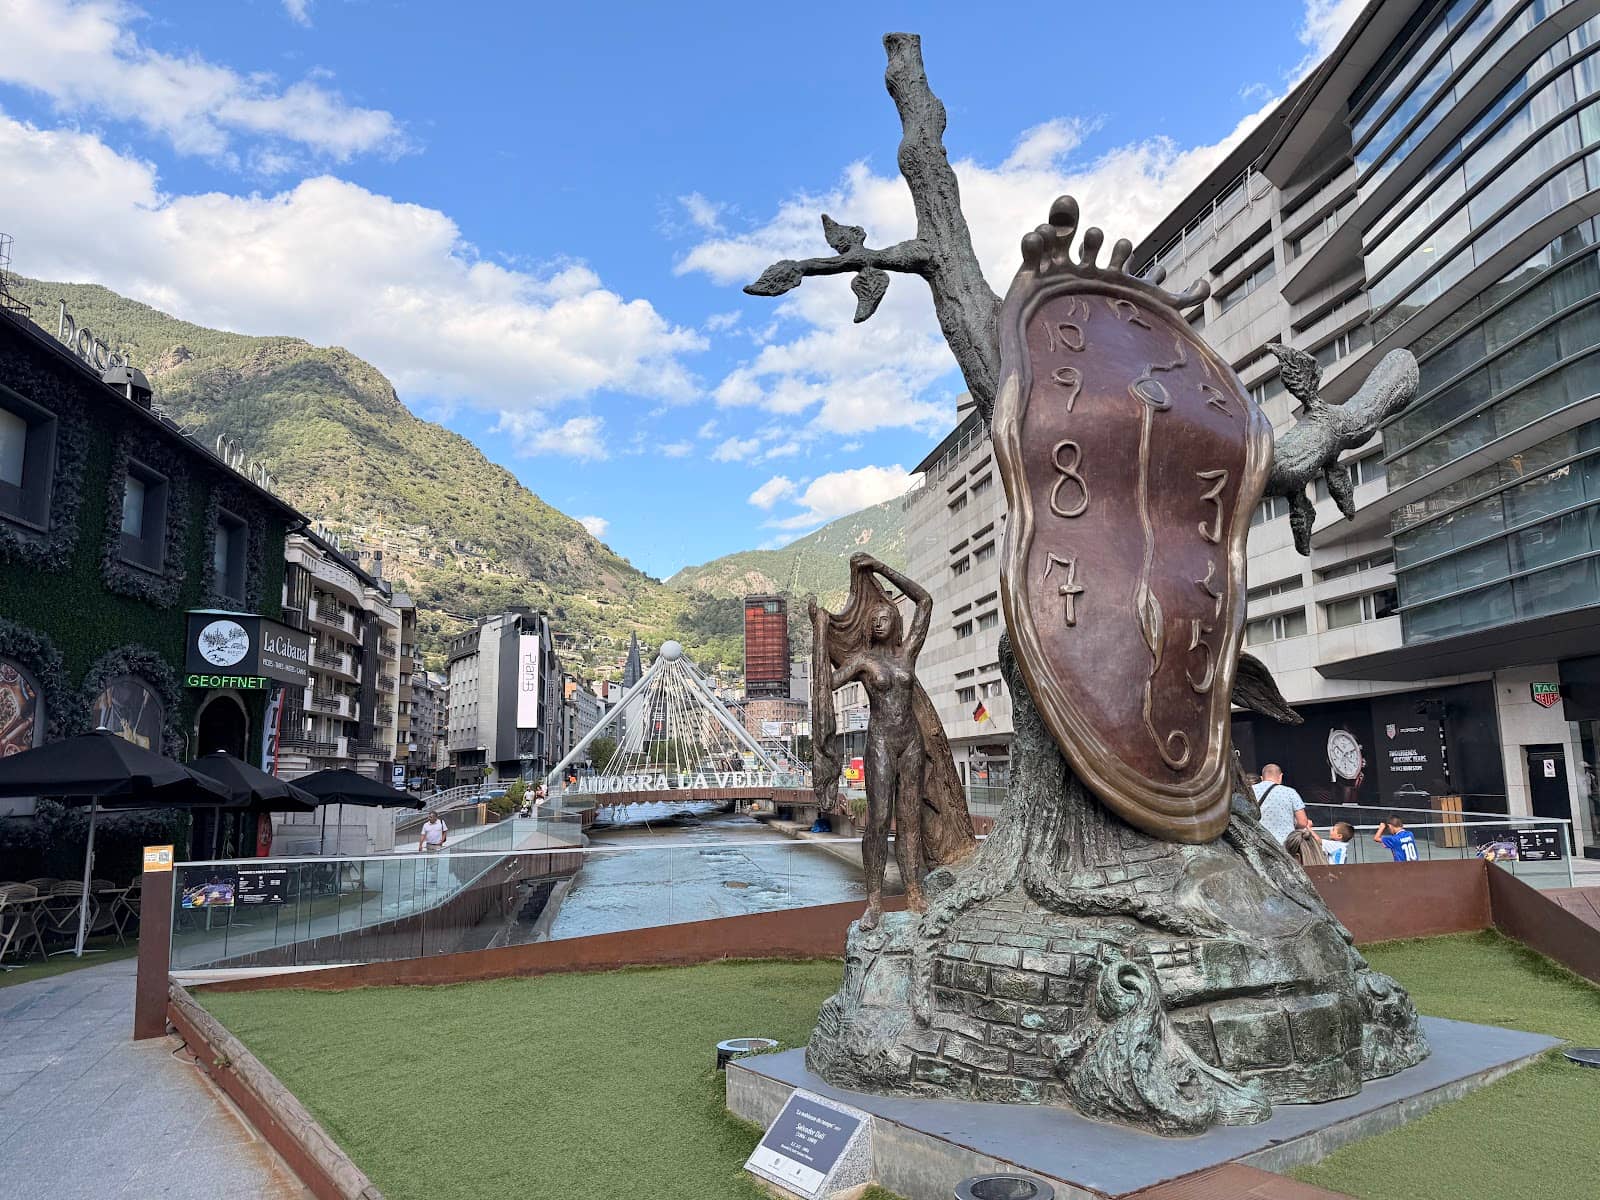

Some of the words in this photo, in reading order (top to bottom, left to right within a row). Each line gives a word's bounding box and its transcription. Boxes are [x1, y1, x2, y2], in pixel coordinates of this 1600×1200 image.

[1040, 322, 1085, 352] 10
[1052, 366, 1083, 413] 9
[1198, 383, 1233, 417] 2
[1050, 439, 1090, 517] 8
[1196, 469, 1229, 544] 3
[1043, 551, 1084, 627] 7
[264, 631, 275, 656] La
[276, 636, 307, 662] Cabana
[1186, 618, 1215, 694] 5
[188, 674, 267, 689] GEOFFNET
[1535, 684, 1557, 693] TAG
[1535, 693, 1560, 706] HEUER
[395, 767, 403, 776] P
[578, 773, 670, 795] ANDORRA
[677, 773, 708, 789] LA
[1401, 843, 1418, 862] 10
